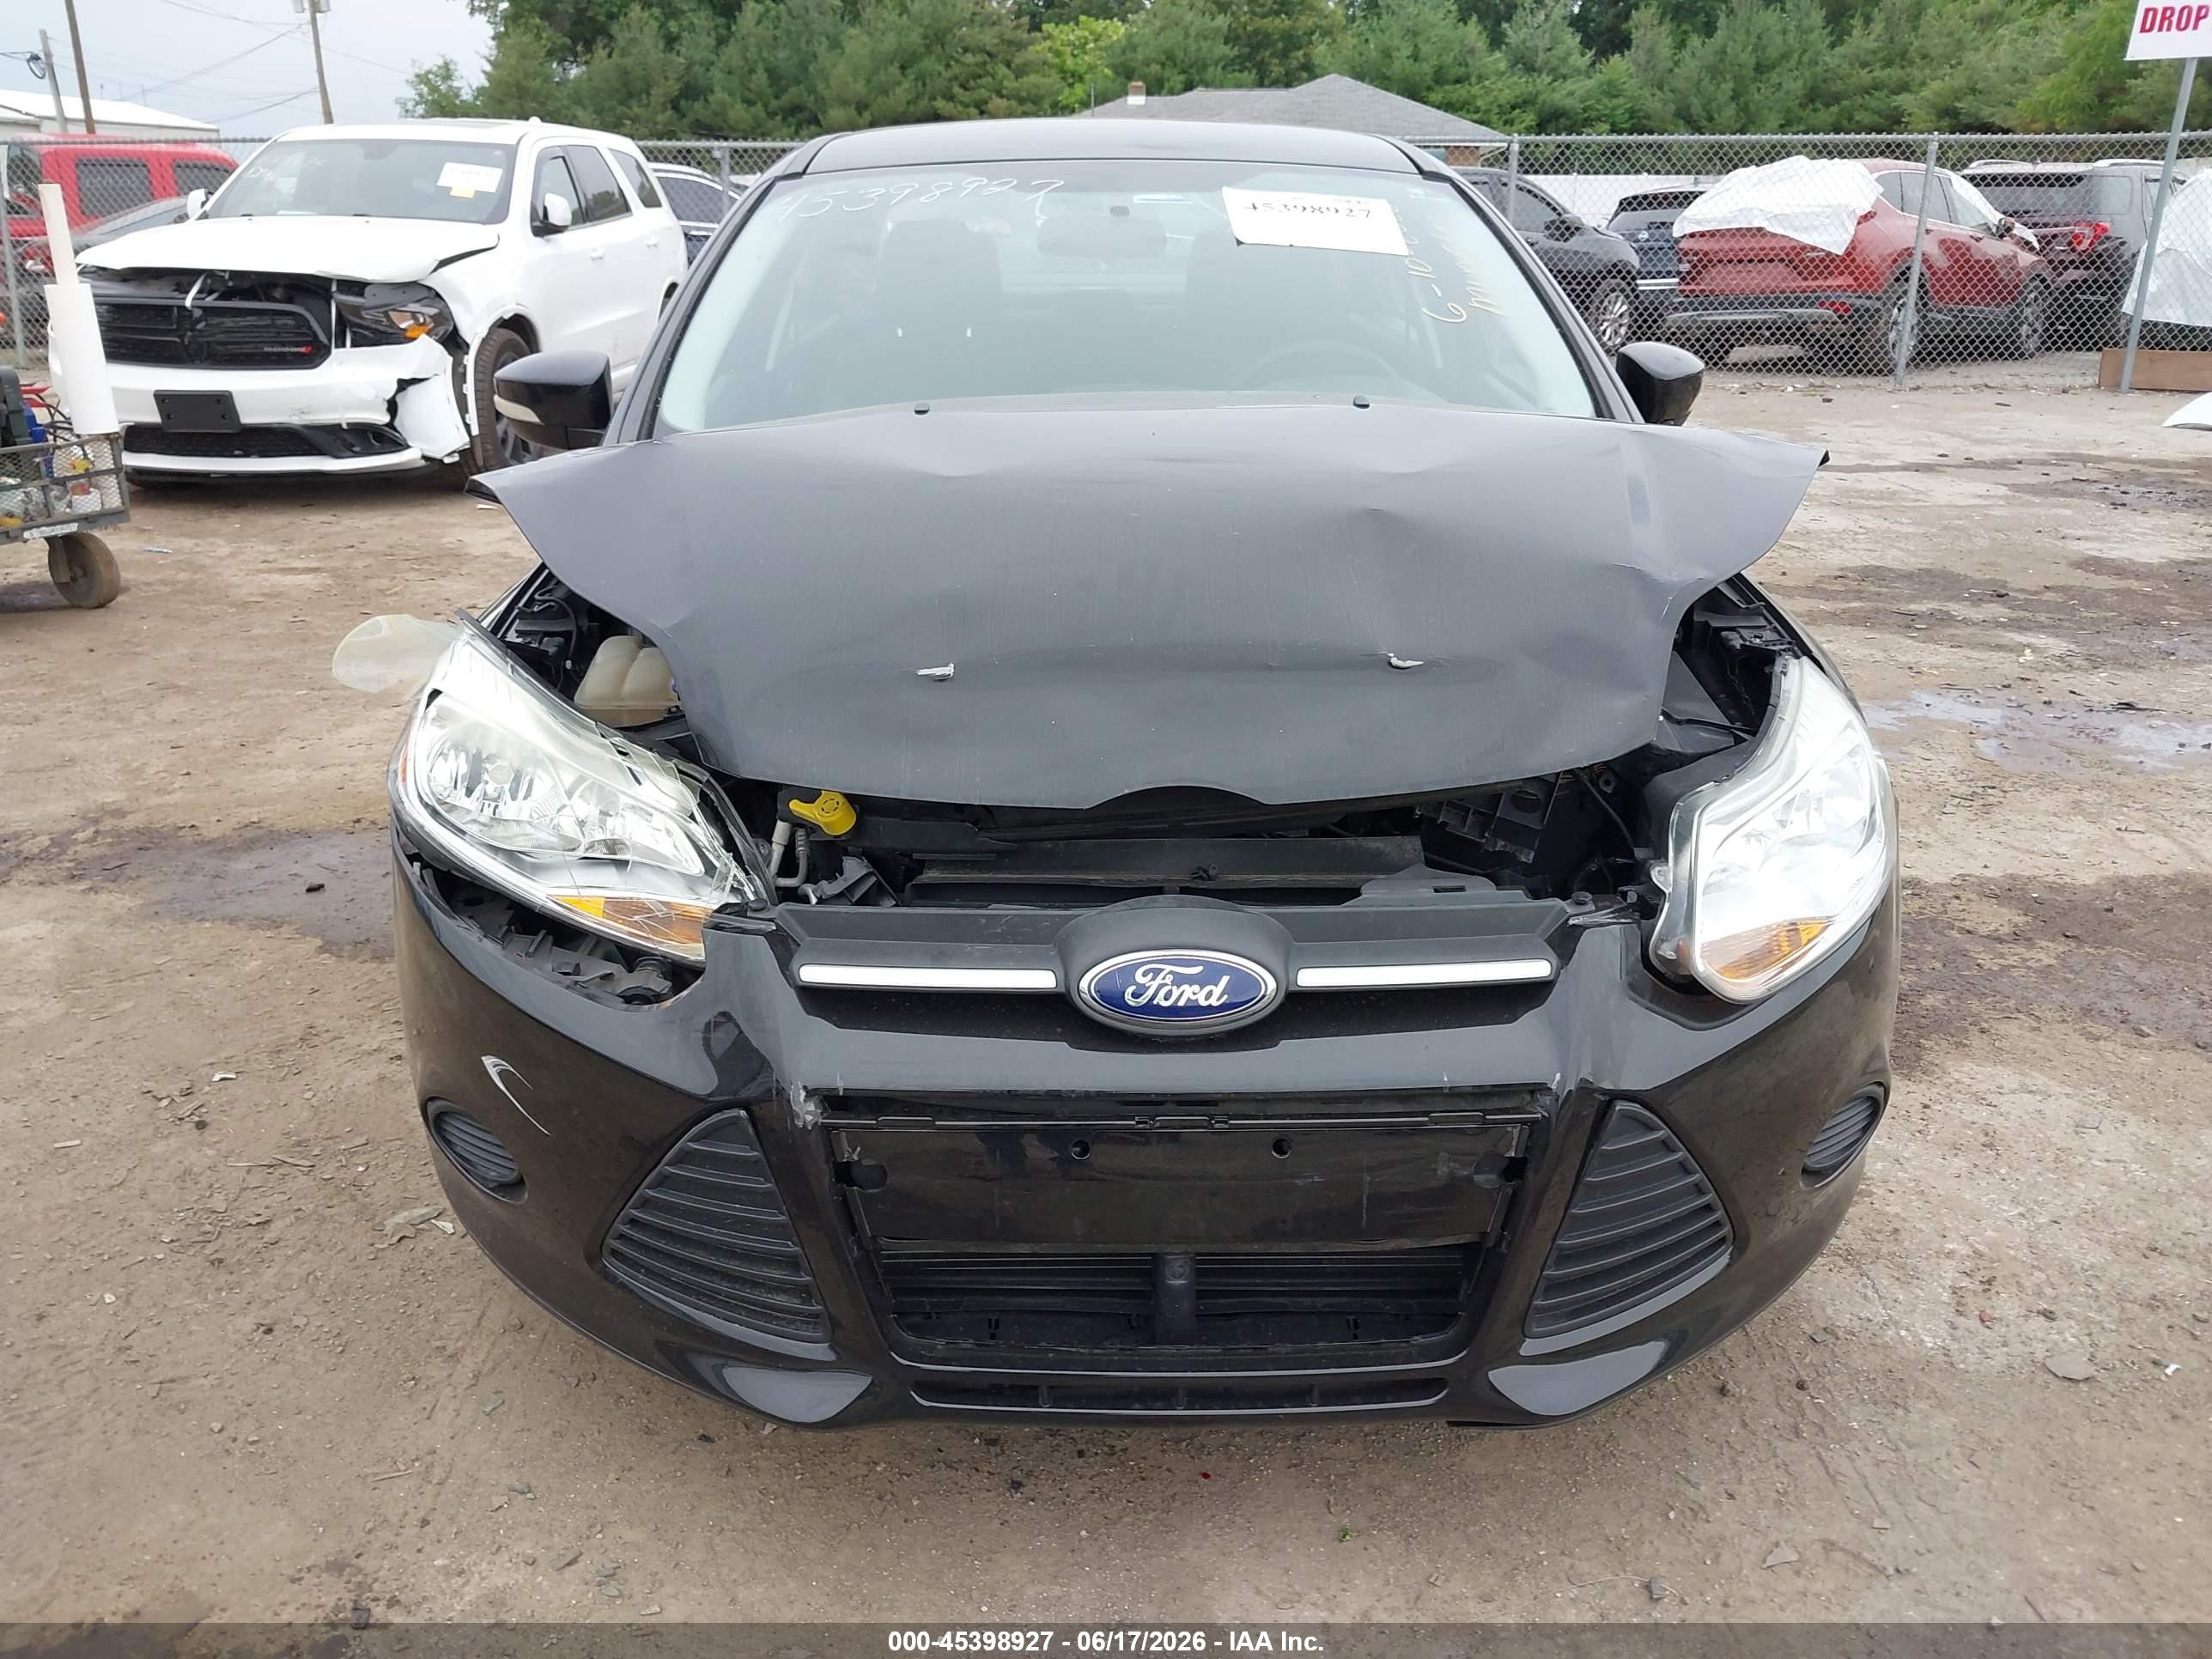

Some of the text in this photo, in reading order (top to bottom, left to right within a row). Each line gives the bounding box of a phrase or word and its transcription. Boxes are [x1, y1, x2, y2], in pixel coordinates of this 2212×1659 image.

[2139, 4, 2210, 33] DROP
[775, 177, 1065, 223] 45398927
[1124, 963, 1231, 1007] Ford
